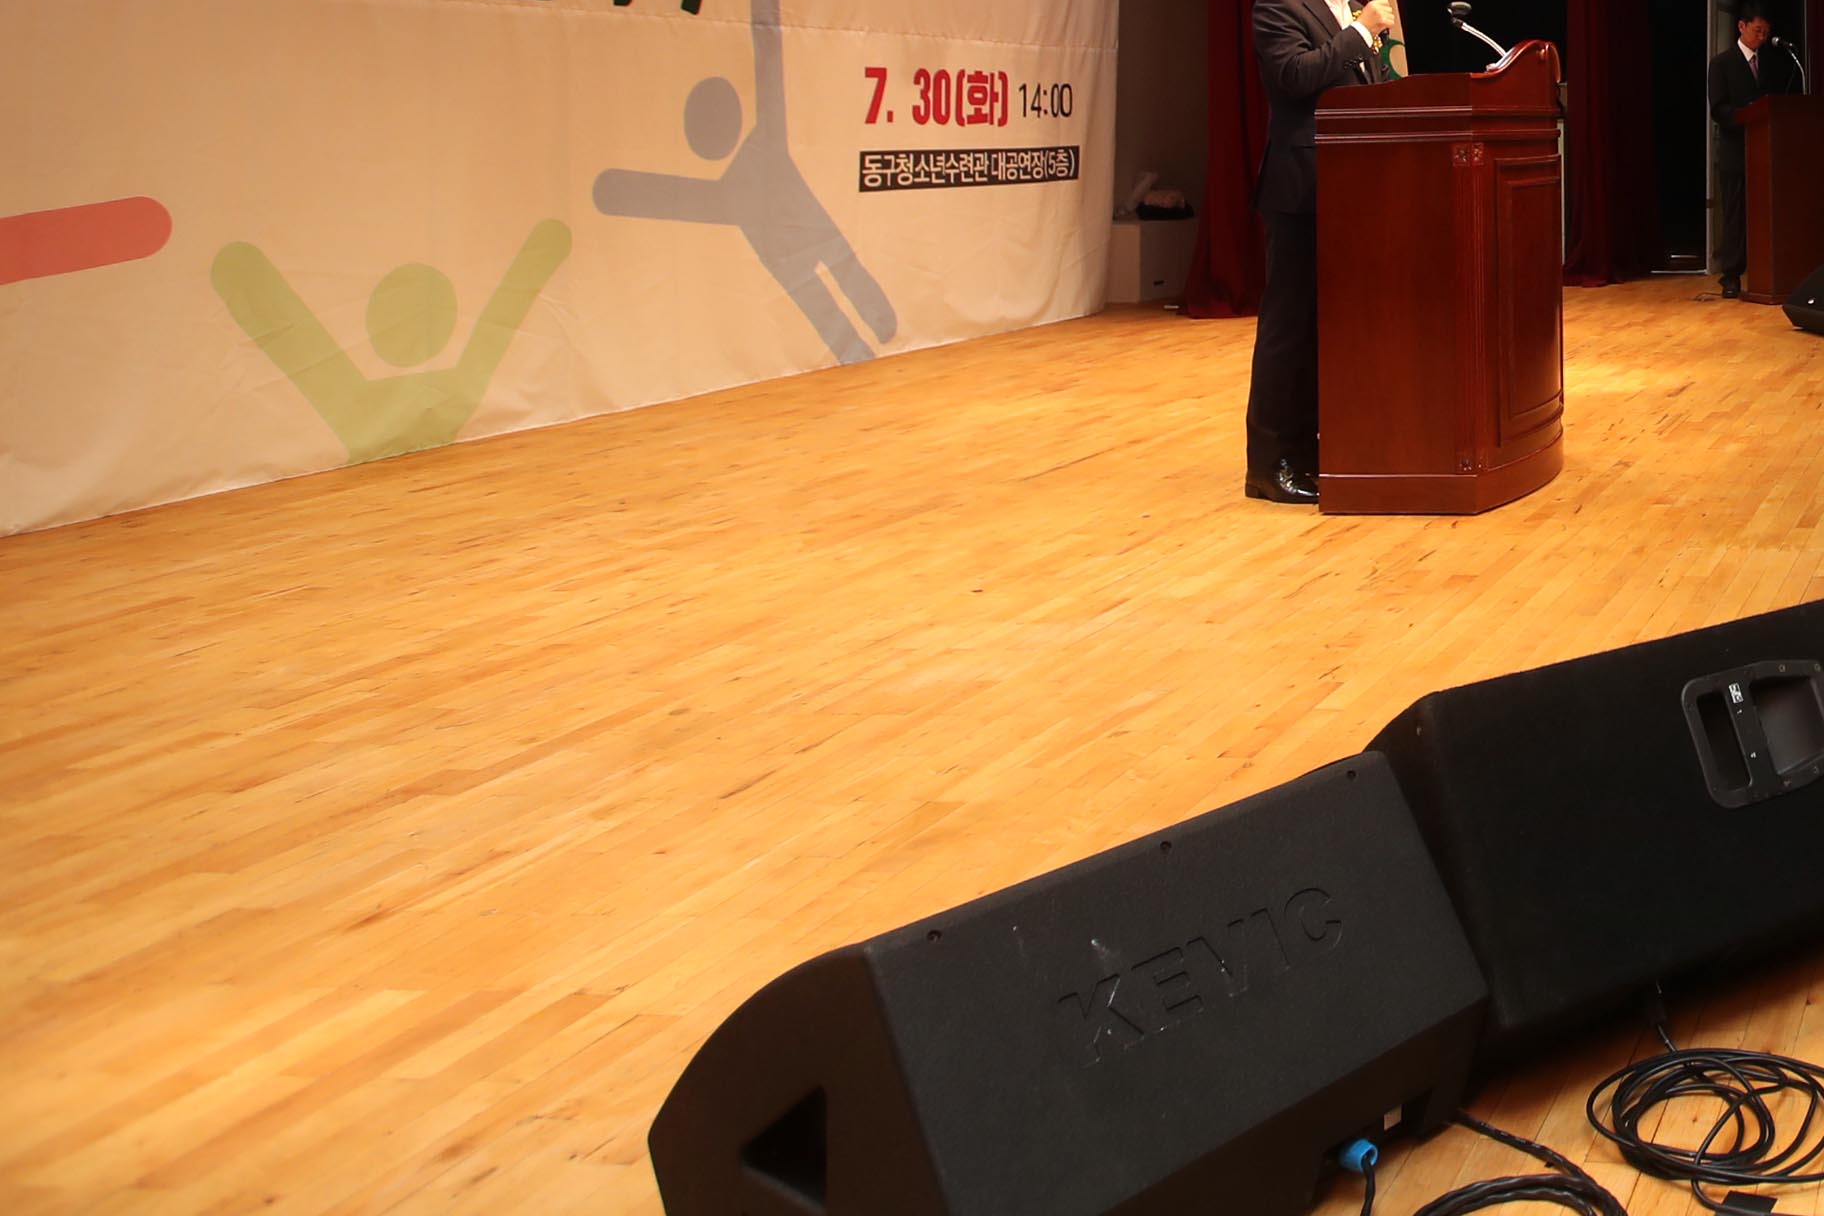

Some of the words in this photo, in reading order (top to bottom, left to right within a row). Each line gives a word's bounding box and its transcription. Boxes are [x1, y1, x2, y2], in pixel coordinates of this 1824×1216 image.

[864, 66, 894, 125] 7.
[911, 67, 1009, 128] 30(화)
[1018, 82, 1073, 120] 14:00
[861, 151, 991, 188] 동구청소년수련관
[990, 147, 1075, 182] 대공연장(5층)
